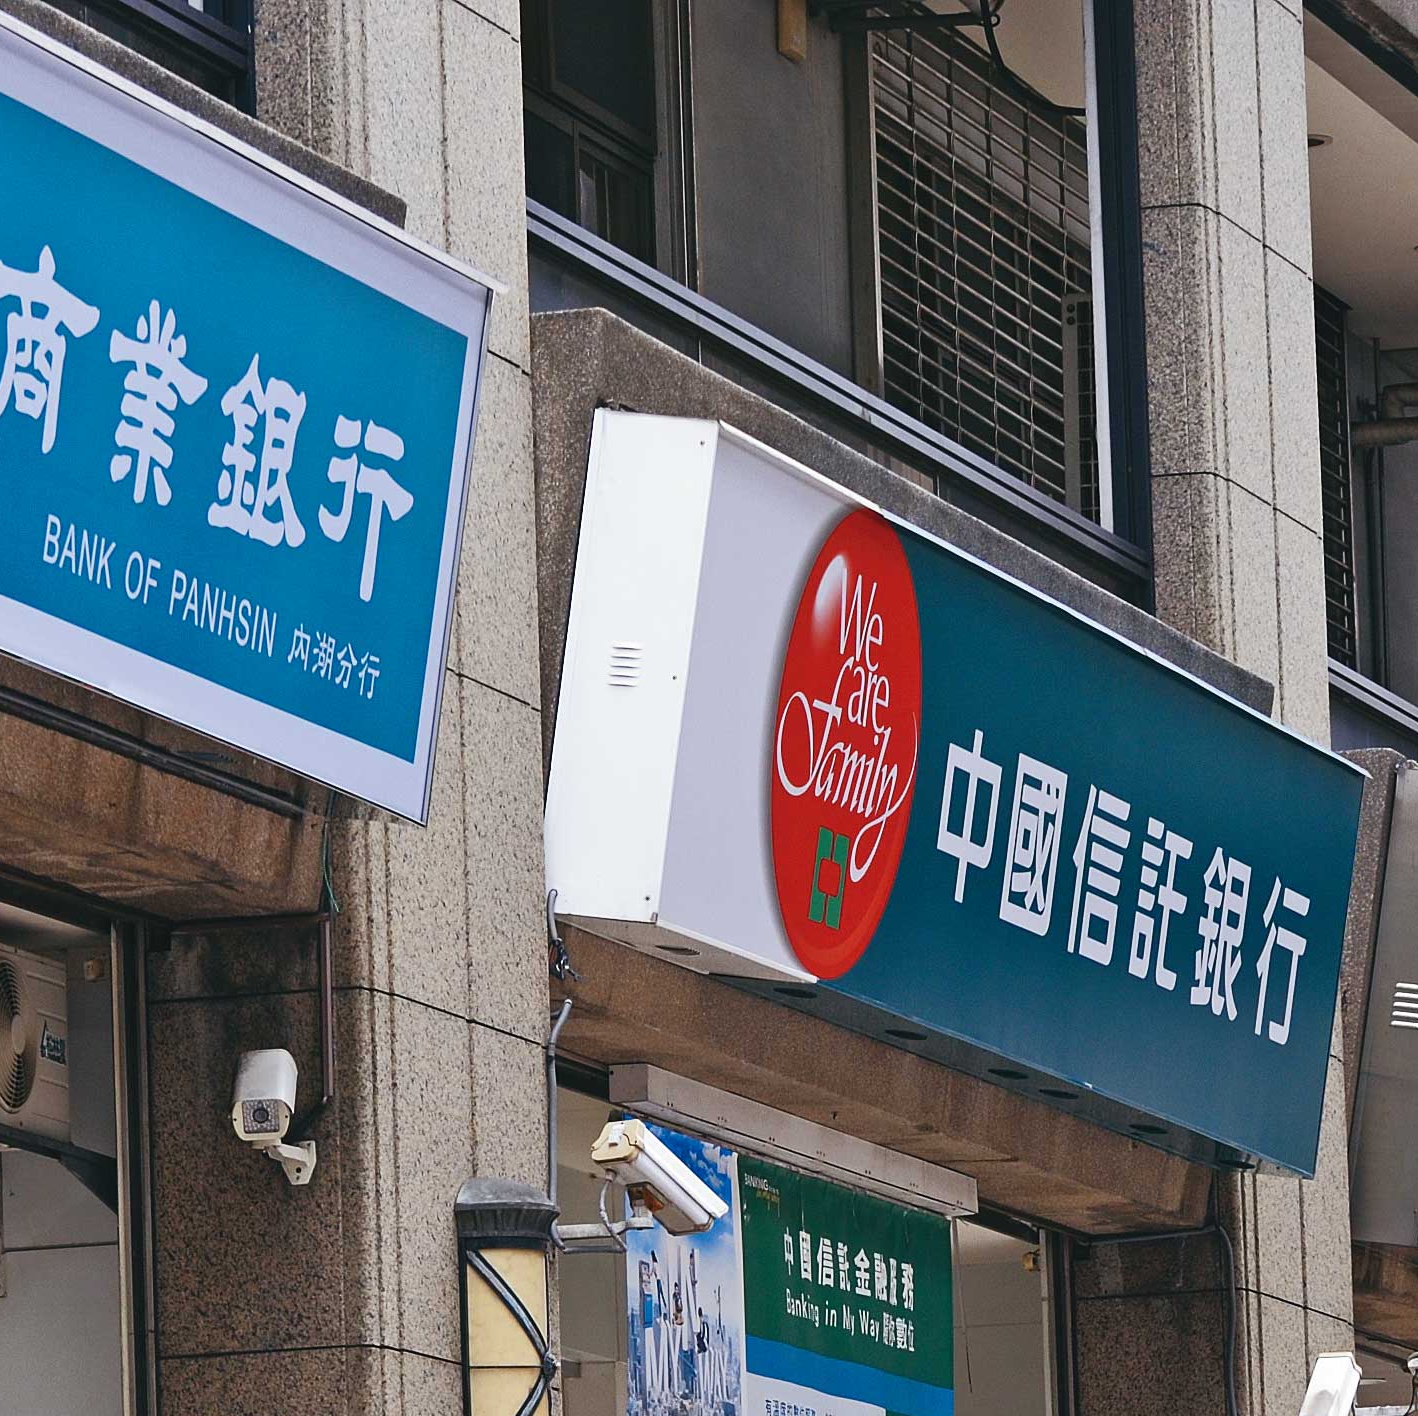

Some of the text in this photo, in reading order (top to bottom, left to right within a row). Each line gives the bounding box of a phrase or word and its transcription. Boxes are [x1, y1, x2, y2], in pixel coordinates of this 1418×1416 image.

[42, 513, 116, 589] BANK
[124, 551, 161, 604] OF
[169, 569, 278, 657] PANHSIN
[838, 572, 884, 672] We
[777, 657, 919, 882] Family
[936, 730, 1313, 1046] 中國信託銀行
[786, 1288, 820, 1327] Banking
[825, 1301, 838, 1327] in
[842, 1304, 855, 1336] My
[859, 1307, 880, 1343] Way
